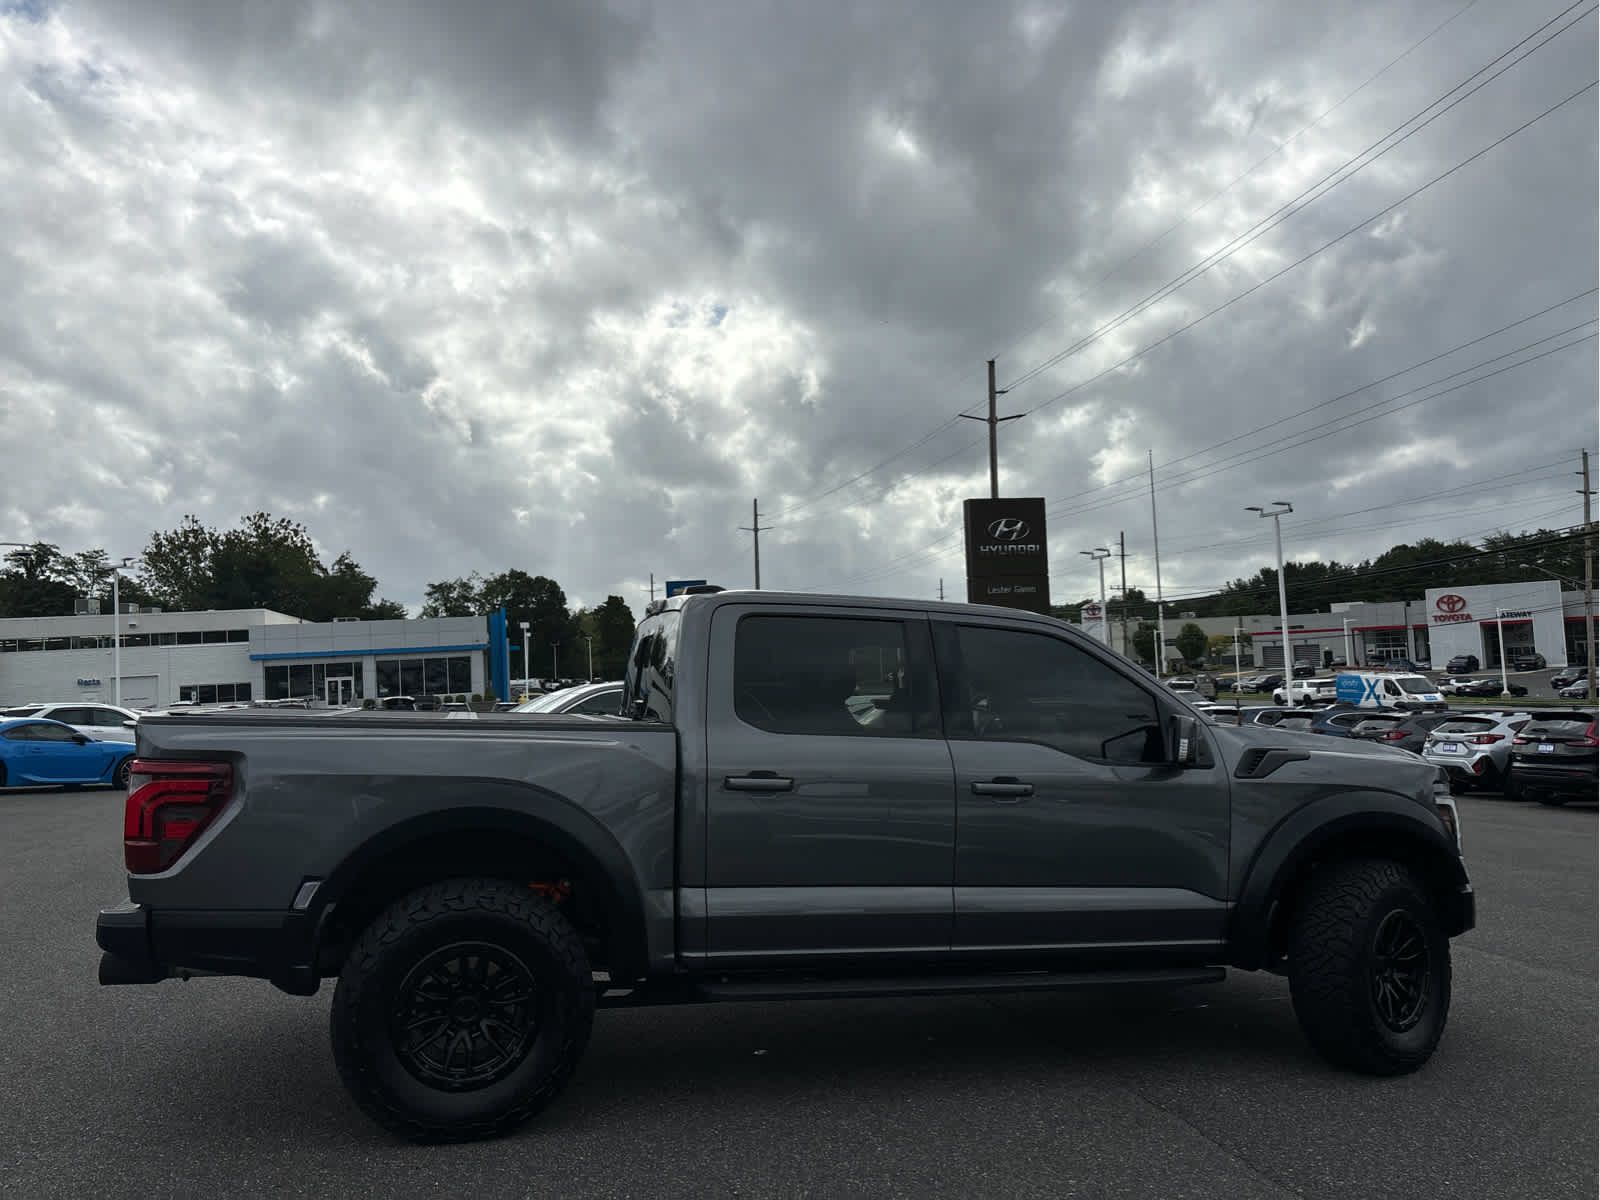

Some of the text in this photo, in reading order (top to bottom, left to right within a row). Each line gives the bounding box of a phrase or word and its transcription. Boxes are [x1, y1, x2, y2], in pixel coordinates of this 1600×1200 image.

[979, 544, 1040, 554] HYUNDAI
[1432, 613, 1473, 623] TOYOTA
[1496, 611, 1532, 619] ATEWAY
